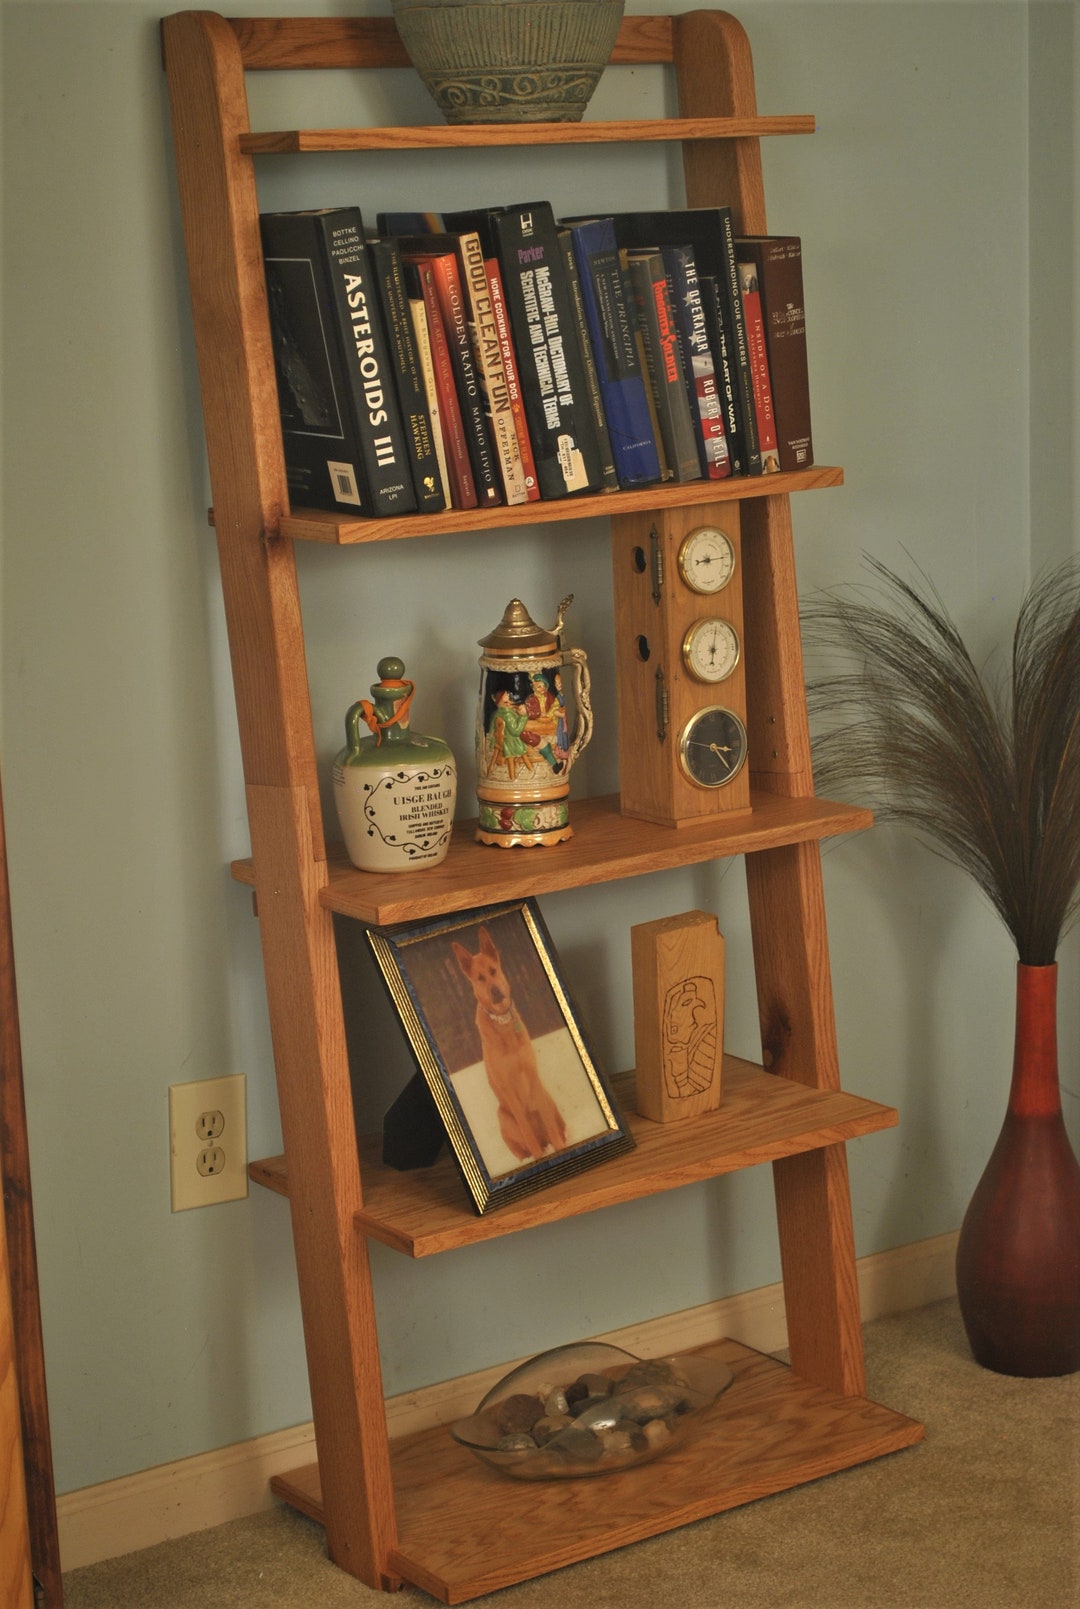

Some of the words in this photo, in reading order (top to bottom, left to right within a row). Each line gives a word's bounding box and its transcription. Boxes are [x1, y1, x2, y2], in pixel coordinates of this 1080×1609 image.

[333, 227, 356, 237] BOTTKE
[333, 236, 359, 246] CELLINO
[332, 245, 364, 256] PAOLICCHI
[339, 256, 360, 264] BINZEL
[518, 246, 544, 264] Parker
[443, 261, 454, 282] THE
[685, 262, 697, 284] THE
[393, 267, 405, 310] ILLUSTRATED
[491, 278, 500, 301] HOME
[520, 270, 540, 323] SCIENTIFIC
[535, 266, 559, 336] McGRAW-HILL
[724, 217, 738, 296] UNDERSTANDING
[737, 323, 747, 366] UNIVERSE
[448, 284, 467, 345] GOLDEN
[465, 238, 487, 292] GOOD
[476, 297, 501, 367] CLEAN
[490, 371, 510, 413] FUN
[495, 303, 507, 339] COOKING
[611, 269, 622, 298] THE
[617, 303, 635, 367] PRINCIPIA
[689, 290, 708, 351] OPERATOR
[388, 291, 398, 322] UNIVERSE
[396, 340, 407, 373] NUTSHELL
[529, 324, 545, 344] AND
[719, 334, 727, 357] THE
[405, 336, 414, 363] HISTORY
[434, 328, 443, 343] ART
[440, 360, 450, 379] WAR
[502, 341, 510, 357] FOR
[571, 280, 583, 320] Introduction
[579, 329, 591, 358] Ordinary
[586, 360, 597, 395] Differential
[592, 395, 604, 427] Equations
[755, 319, 763, 358] INSIDE
[760, 365, 766, 377] OF
[344, 273, 388, 426] ASTEROIDS
[374, 436, 395, 467] III
[410, 366, 416, 374] OF
[460, 350, 477, 397] RATIO
[505, 360, 515, 382] YOUR
[533, 344, 554, 396] TECHNICAL
[548, 336, 571, 393] DICTIONARY
[722, 360, 730, 384] ART
[412, 377, 420, 393] TIME
[509, 383, 518, 399] DOG
[725, 385, 733, 402] OF
[542, 395, 560, 430] TERMS
[559, 394, 574, 406] OF
[703, 379, 719, 420] ROBERT
[727, 403, 736, 433] WAR
[410, 415, 424, 460] HAWKING
[418, 414, 431, 456] STEPHEN
[473, 407, 485, 446] MARIO
[480, 451, 491, 482] LIVIO
[511, 434, 519, 460] NICK
[623, 440, 651, 450] CALIFORNIA
[710, 425, 726, 467] O'NEILL
[498, 419, 514, 481] OFFERMAN
[380, 484, 404, 494] ARIZONA
[394, 794, 424, 805] UISGE
[427, 789, 451, 801] BAUGH
[411, 803, 443, 813] BLENDED
[400, 813, 420, 821] IRISH
[422, 808, 449, 818] WHISKEY
